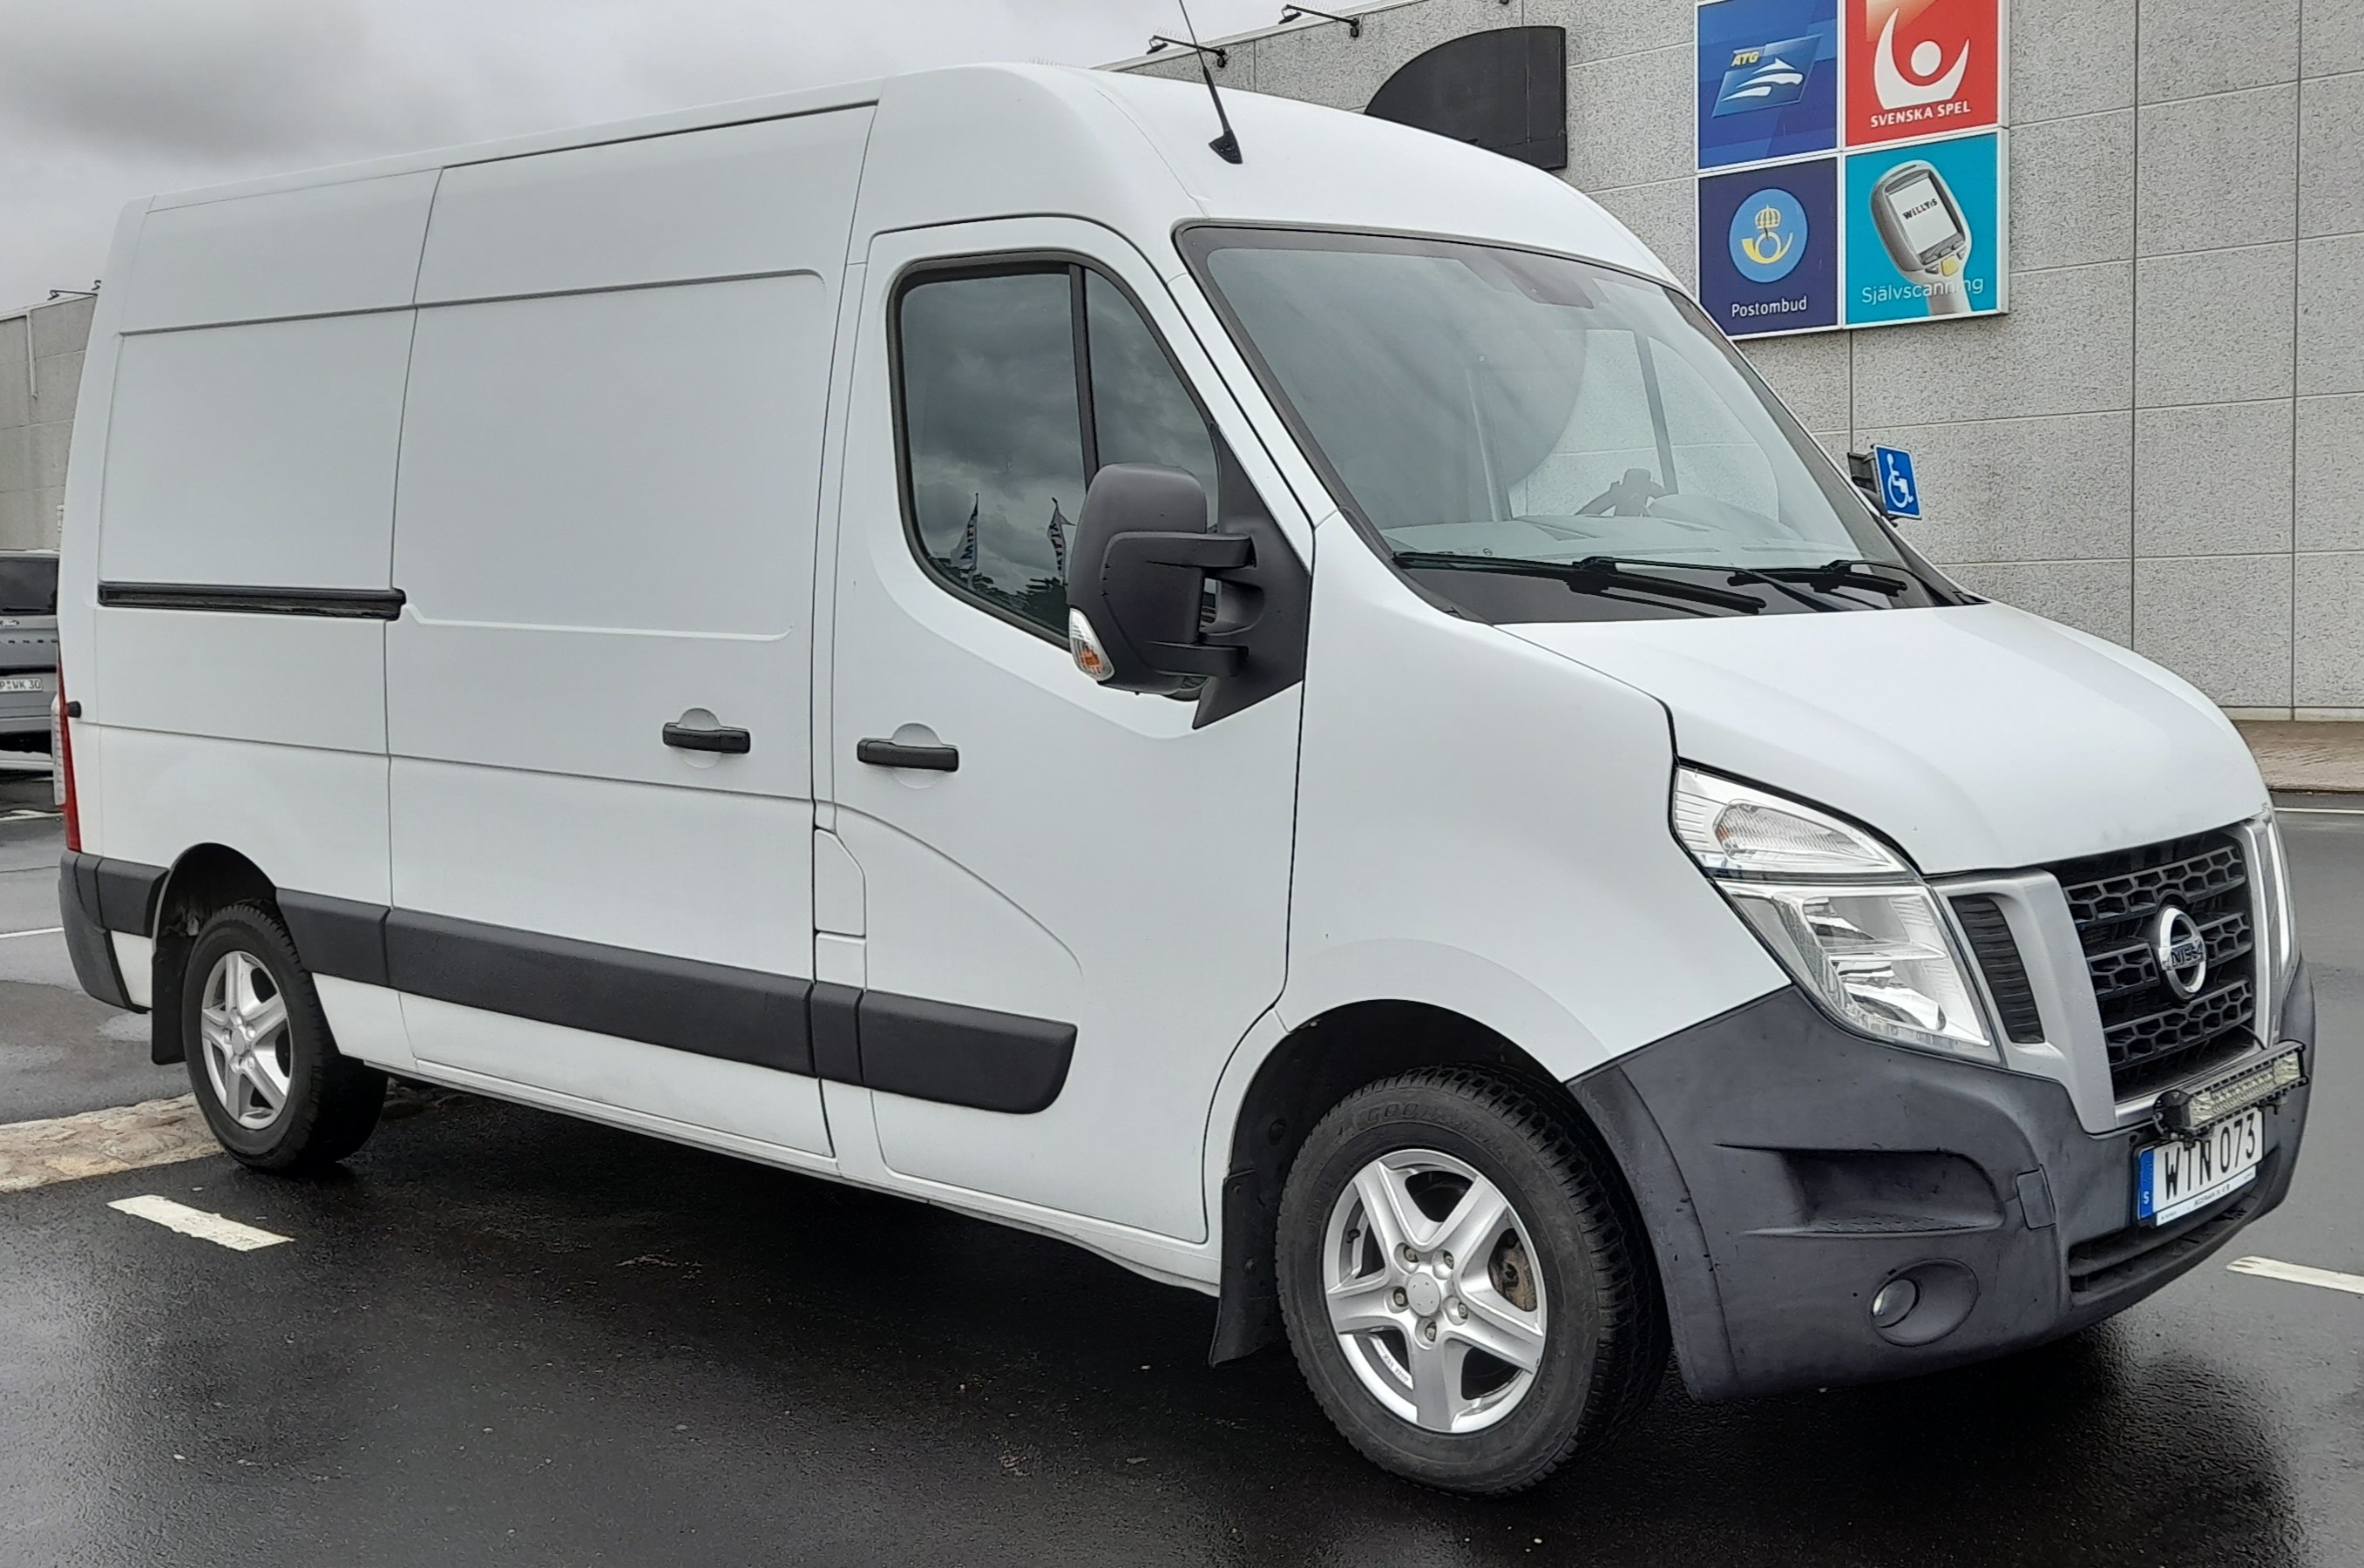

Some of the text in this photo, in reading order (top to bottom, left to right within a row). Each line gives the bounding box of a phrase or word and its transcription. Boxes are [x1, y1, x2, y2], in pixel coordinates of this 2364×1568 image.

[1731, 51, 1759, 67] ATG
[1870, 100, 1971, 128] SVENSKA SPEL
[1861, 278, 1984, 306] Självscannng
[1731, 294, 1807, 318] Postombud
[2164, 1139, 2212, 1200] WTN
[2220, 1112, 2255, 1173] 073
[2143, 1191, 2151, 1205] S
